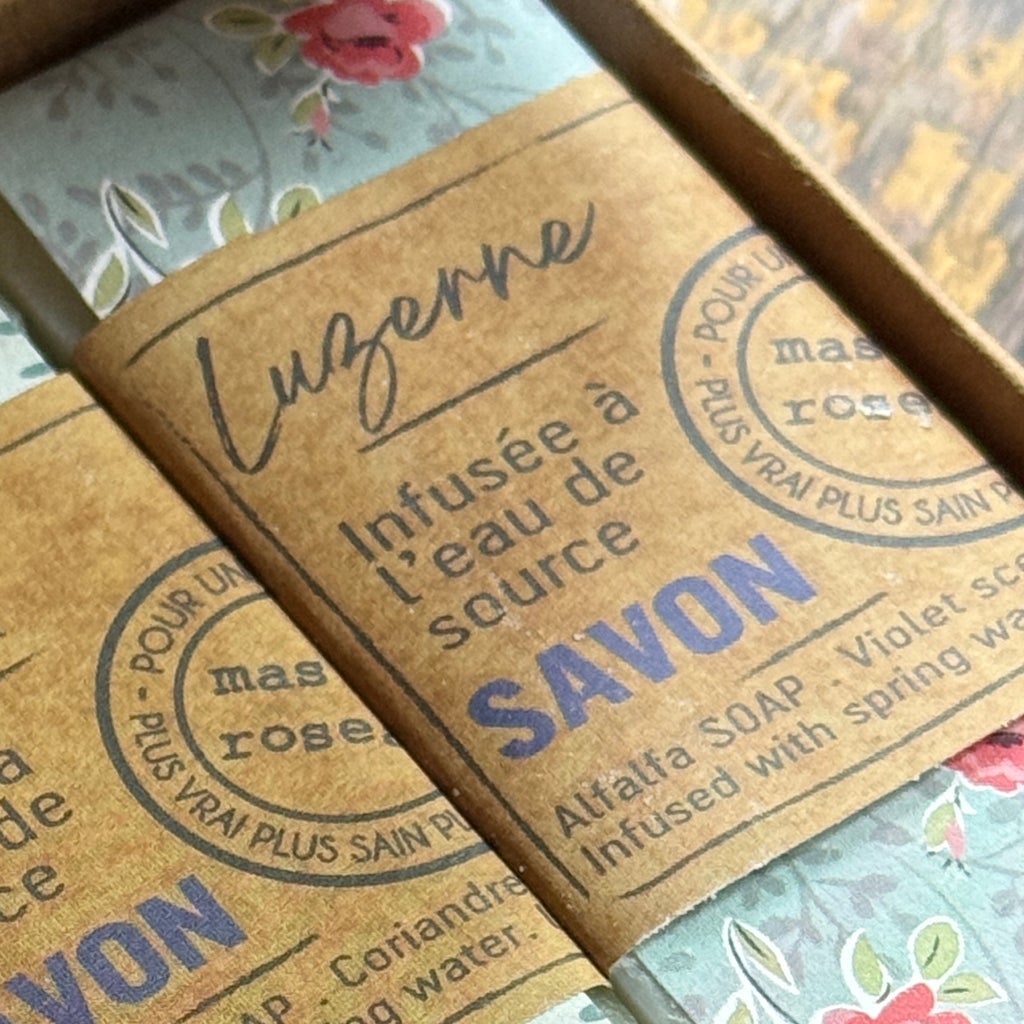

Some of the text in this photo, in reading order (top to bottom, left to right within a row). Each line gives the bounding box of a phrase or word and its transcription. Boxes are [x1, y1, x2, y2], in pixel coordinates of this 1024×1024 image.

[197, 201, 596, 475] Luzerne
[693, 264, 763, 344] POUR
[770, 336, 883, 365] mas
[338, 381, 640, 564] Infusée à
[564, 449, 645, 508] de
[695, 377, 751, 445] PLUS
[742, 440, 815, 500] VRAI
[815, 486, 903, 525] PLUS
[913, 488, 992, 526] SAIN
[129, 589, 205, 674] POUR
[428, 518, 641, 650] source
[467, 533, 818, 760] SAVON
[208, 660, 328, 696] mas
[552, 741, 697, 839] Alfalfa
[697, 673, 805, 749] SOAP
[833, 593, 967, 668] Violet
[129, 711, 186, 782] PLUS
[174, 775, 250, 840] VRAI
[249, 824, 339, 863] PLUS
[350, 821, 432, 864] SAIN
[580, 766, 741, 876] Infused
[744, 720, 839, 778] with
[842, 645, 973, 725] spring
[329, 874, 529, 988] Coriandre
[402, 923, 539, 1002] water.
